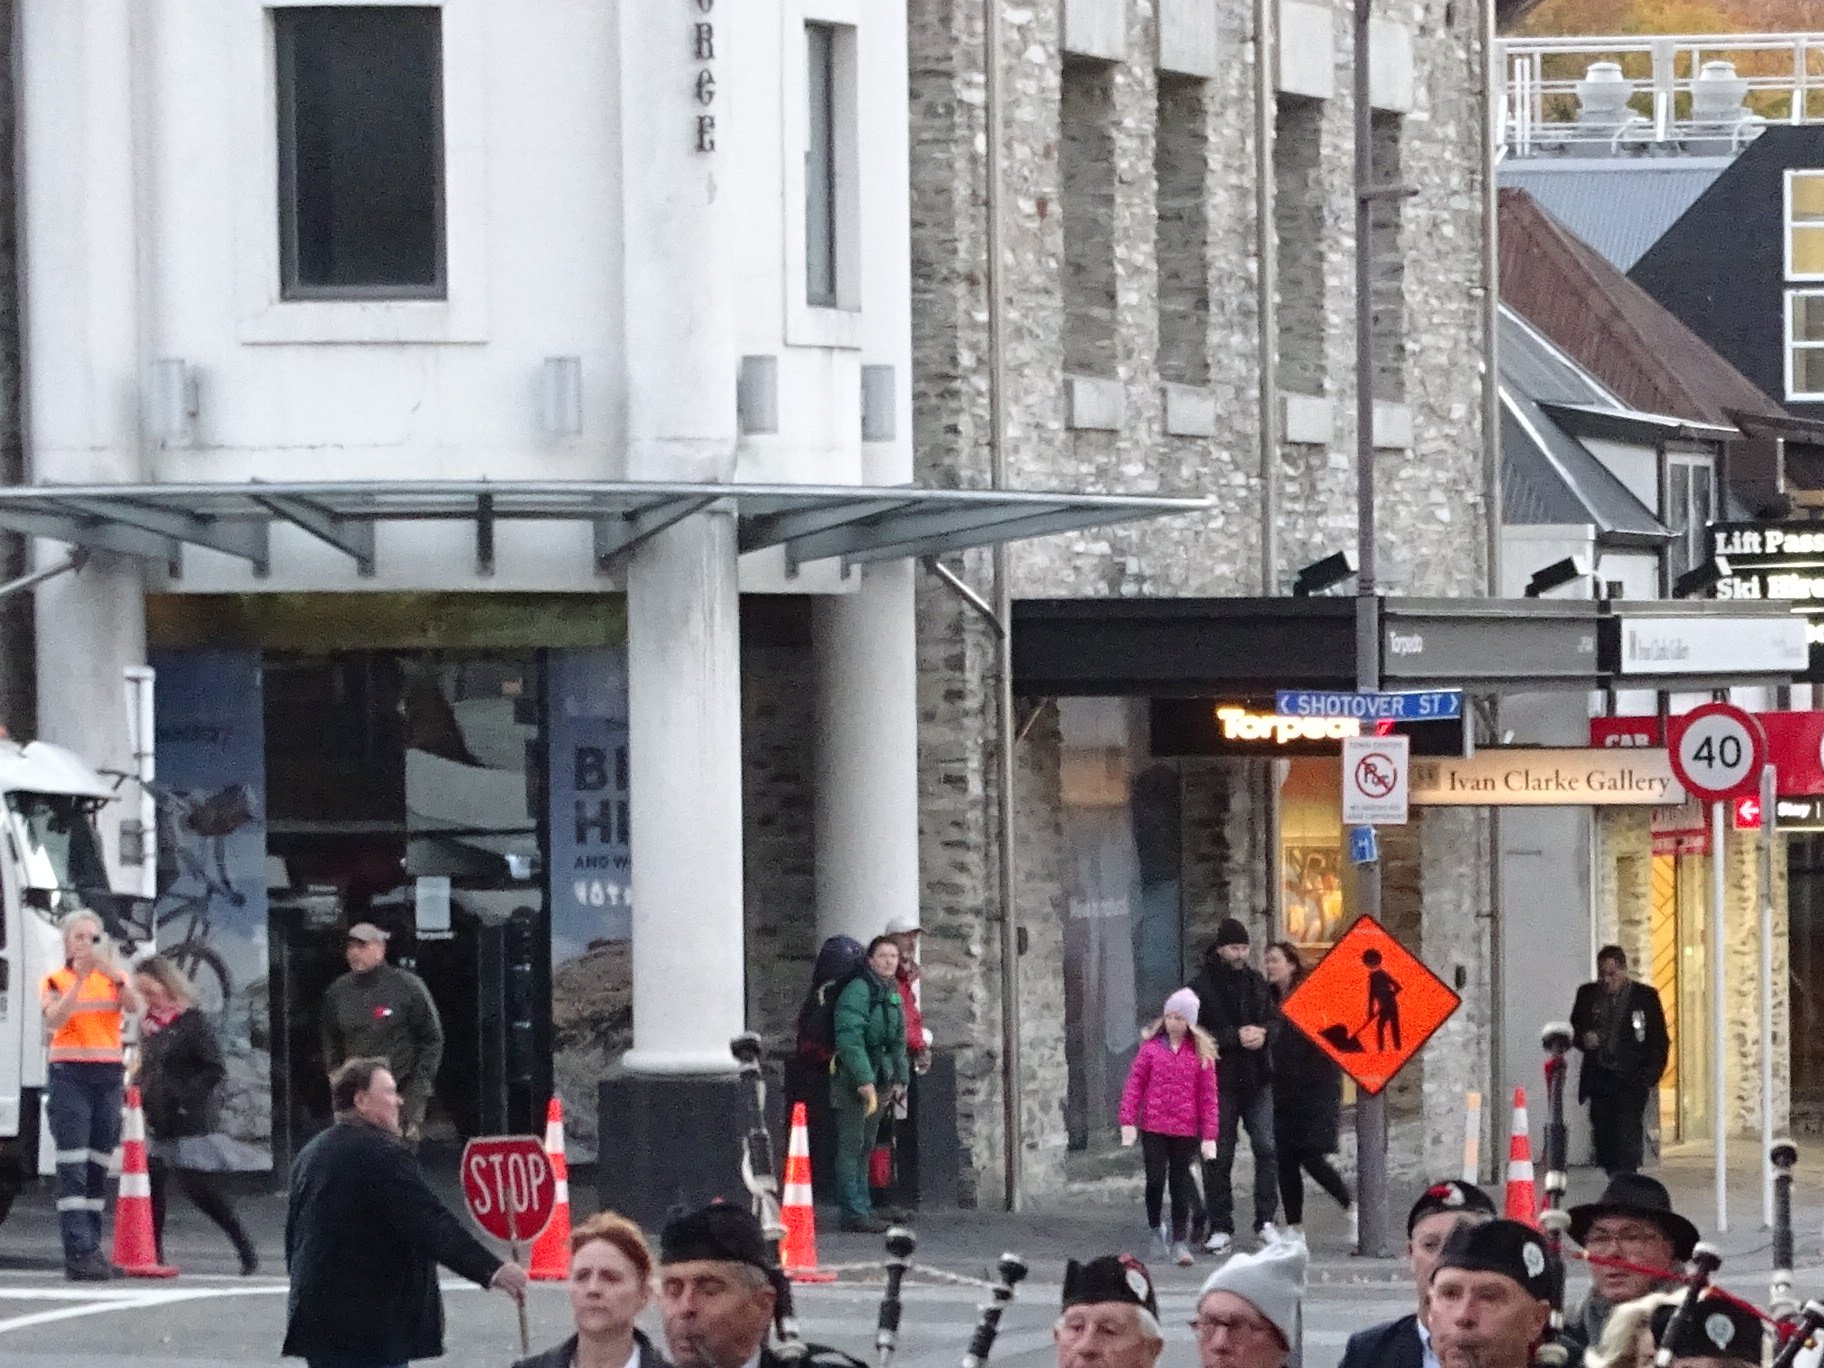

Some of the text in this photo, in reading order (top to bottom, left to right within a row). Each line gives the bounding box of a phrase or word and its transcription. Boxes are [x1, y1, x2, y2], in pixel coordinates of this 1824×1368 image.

[1715, 531, 1762, 553] Lift
[1716, 576, 1761, 600] Ski
[1297, 694, 1443, 716] SHOTOVER ST
[1692, 735, 1741, 769] 40
[1450, 769, 1671, 797] Ivan Clarke Gallery
[470, 1152, 546, 1215] STOP
